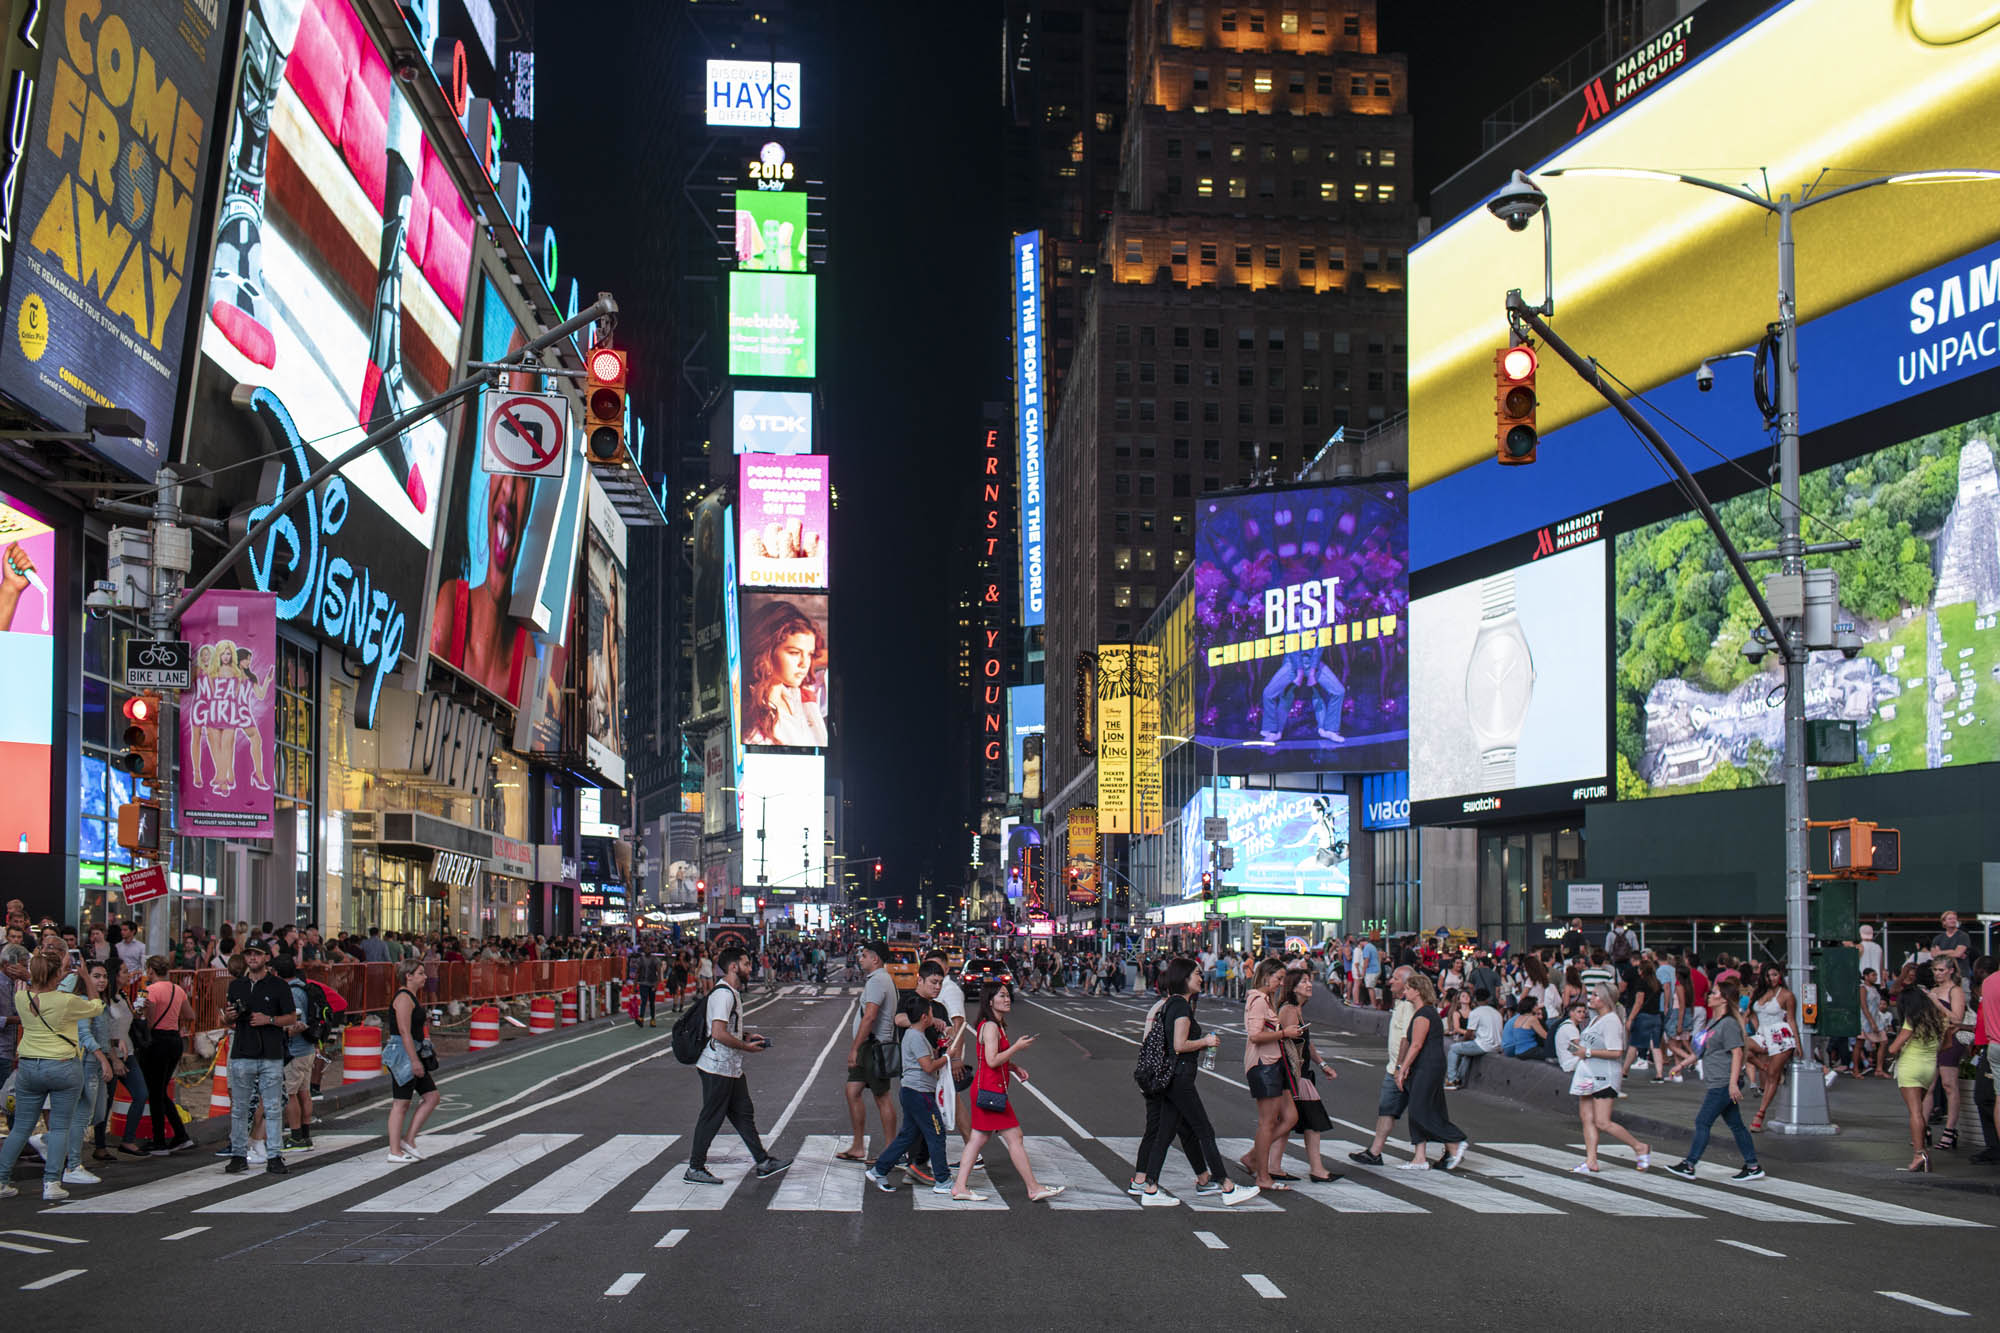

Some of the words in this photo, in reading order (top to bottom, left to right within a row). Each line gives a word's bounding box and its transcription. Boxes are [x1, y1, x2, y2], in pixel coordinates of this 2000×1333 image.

[1616, 16, 1694, 81] MARRIOTT
[712, 68, 768, 80] DISCOVER
[1616, 45, 1684, 102] MARQUIS
[63, 0, 204, 194] COME
[714, 81, 791, 110] HAYS
[749, 161, 794, 179] 2018
[30, 172, 183, 352] AWAY
[1021, 243, 1035, 292] MEET
[1910, 258, 2000, 334] SAM
[27, 256, 40, 274] THE
[41, 268, 84, 310] REMARKABLE
[84, 300, 101, 322] TRUE
[100, 317, 120, 337] STORY
[120, 330, 133, 349] NOW
[133, 343, 143, 356] ON
[142, 350, 171, 379] BROADWAY
[1024, 296, 1036, 332] THE
[1899, 320, 2000, 386] UNPAC
[1024, 335, 1038, 406] PEOPLE
[754, 415, 808, 432] TDK
[1026, 408, 1040, 504] CHANGING
[984, 430, 1000, 556] ERNST
[1028, 506, 1041, 543] THE
[1557, 510, 1604, 536] MARRIOTT
[1557, 526, 1598, 549] MARQUIS
[750, 570, 820, 584] DUNKIN'
[1030, 545, 1042, 613] WORLD
[986, 584, 1000, 602] &
[1265, 576, 1340, 636] BEST
[130, 671, 153, 682] BIKE
[158, 672, 186, 684] LANE
[196, 676, 252, 705] MEAN
[984, 630, 1000, 760] YOUNG
[1804, 688, 1830, 704] ARK
[193, 700, 252, 727] GIRLS
[1102, 744, 1127, 759] KING
[1103, 731, 1124, 743] LION
[1070, 814, 1095, 824] BUBBA
[1463, 797, 1495, 813] swatch
[1072, 826, 1093, 836] GUMP
[131, 870, 156, 881] STANDING
[433, 851, 472, 886] FOREVER
[468, 859, 480, 887] 21
[125, 880, 146, 890] Anytime
[1362, 920, 1387, 934] 1515
